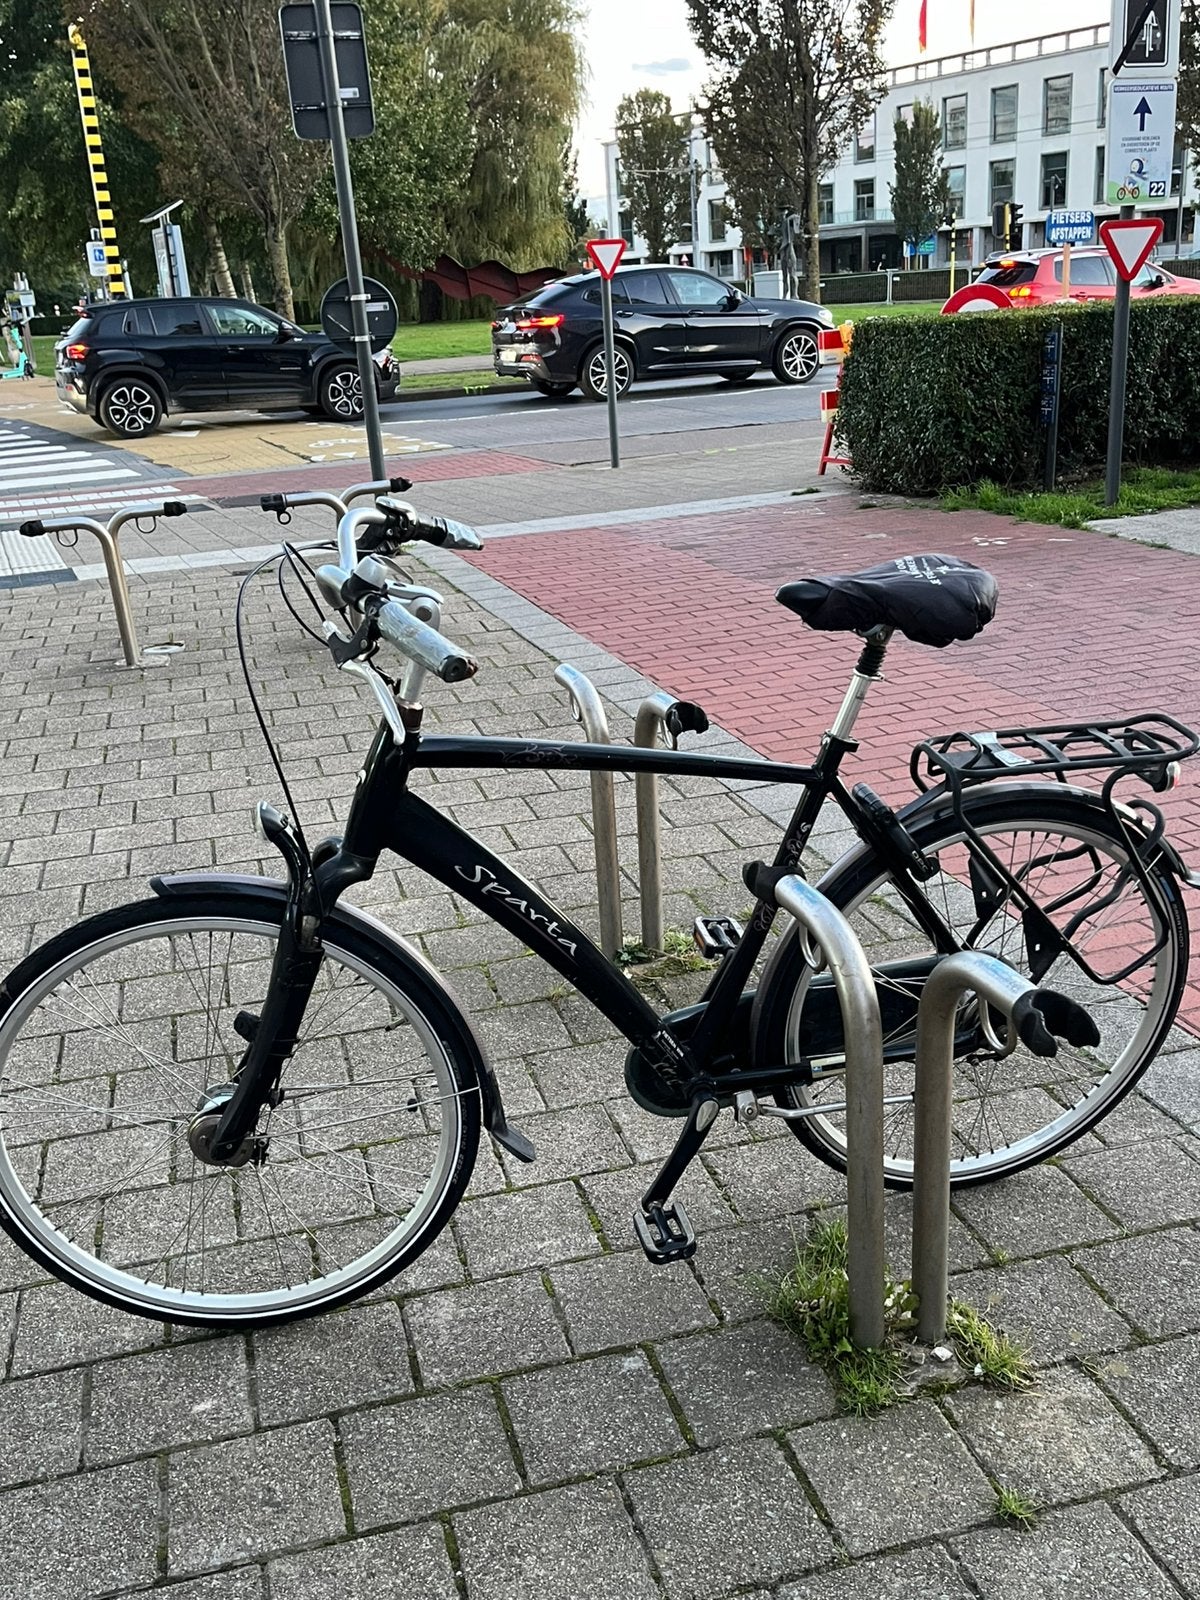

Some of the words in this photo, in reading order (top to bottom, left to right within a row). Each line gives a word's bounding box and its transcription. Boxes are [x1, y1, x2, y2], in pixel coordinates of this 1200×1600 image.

[1150, 182, 1165, 196] 22
[1051, 212, 1092, 224] FIETSERS
[1050, 226, 1093, 241] AFSTAPPEN
[454, 865, 577, 957] Sparta
